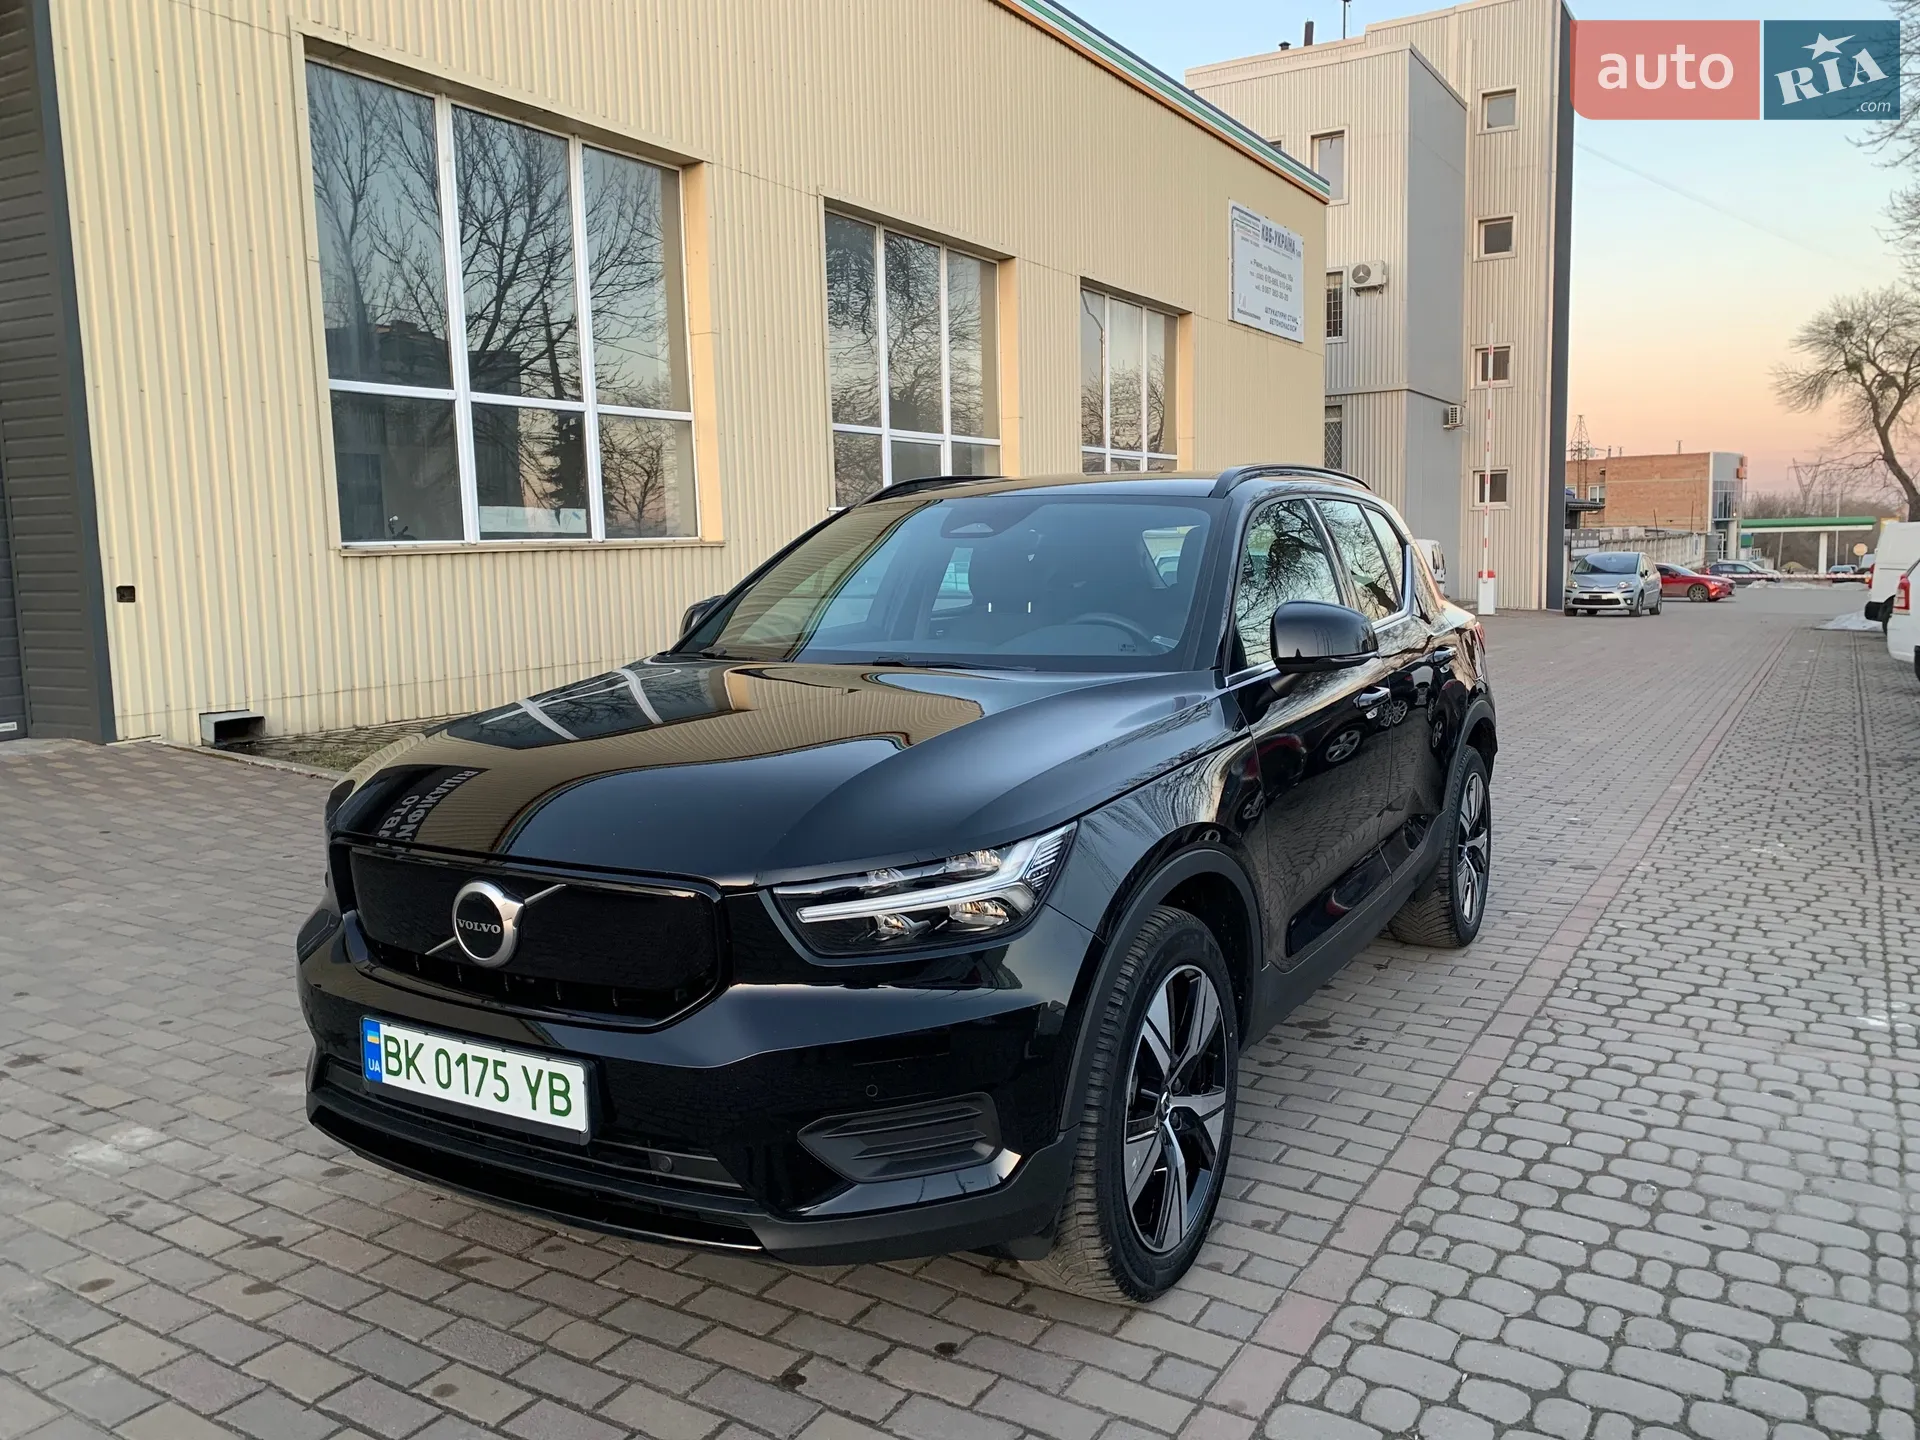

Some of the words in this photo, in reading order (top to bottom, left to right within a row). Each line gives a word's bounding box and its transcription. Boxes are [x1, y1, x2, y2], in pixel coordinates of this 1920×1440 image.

[457, 918, 501, 934] VOLVO
[368, 1058, 381, 1073] UA
[384, 1034, 426, 1085] BK
[434, 1047, 510, 1102] 0175
[521, 1065, 572, 1117] YB
